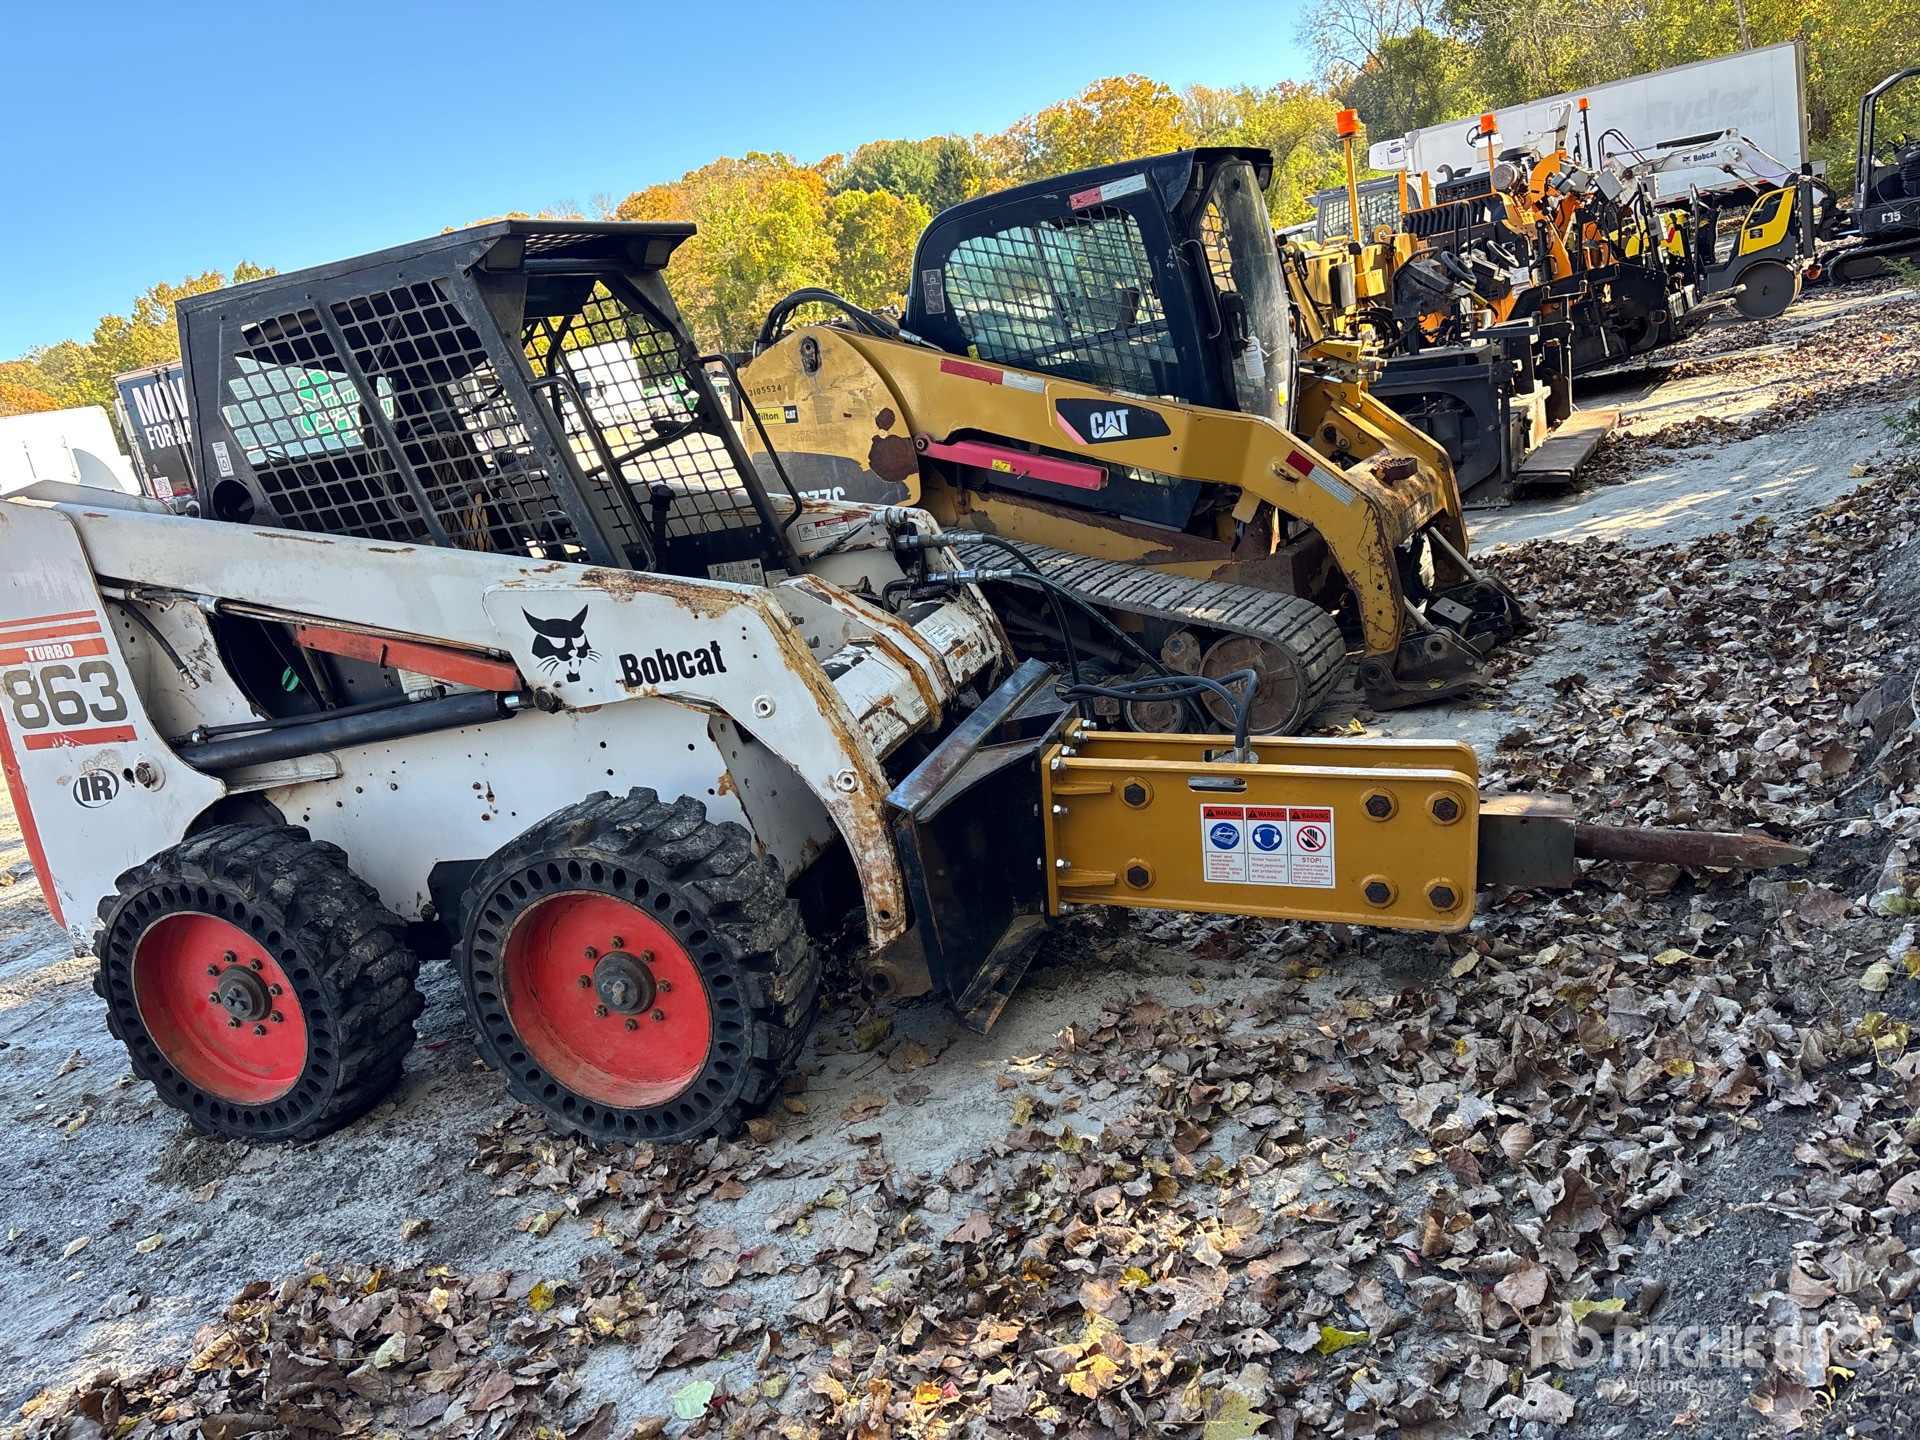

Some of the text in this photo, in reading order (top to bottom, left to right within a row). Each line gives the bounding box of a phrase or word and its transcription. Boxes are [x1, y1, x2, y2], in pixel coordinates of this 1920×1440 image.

[1694, 150, 1716, 162] Bobcat
[1090, 408, 1128, 438] CAT
[145, 424, 176, 450] FOR
[25, 643, 74, 661] TURBO
[619, 640, 727, 687] Bobcat
[3, 660, 128, 730] 863
[78, 776, 114, 801] IR
